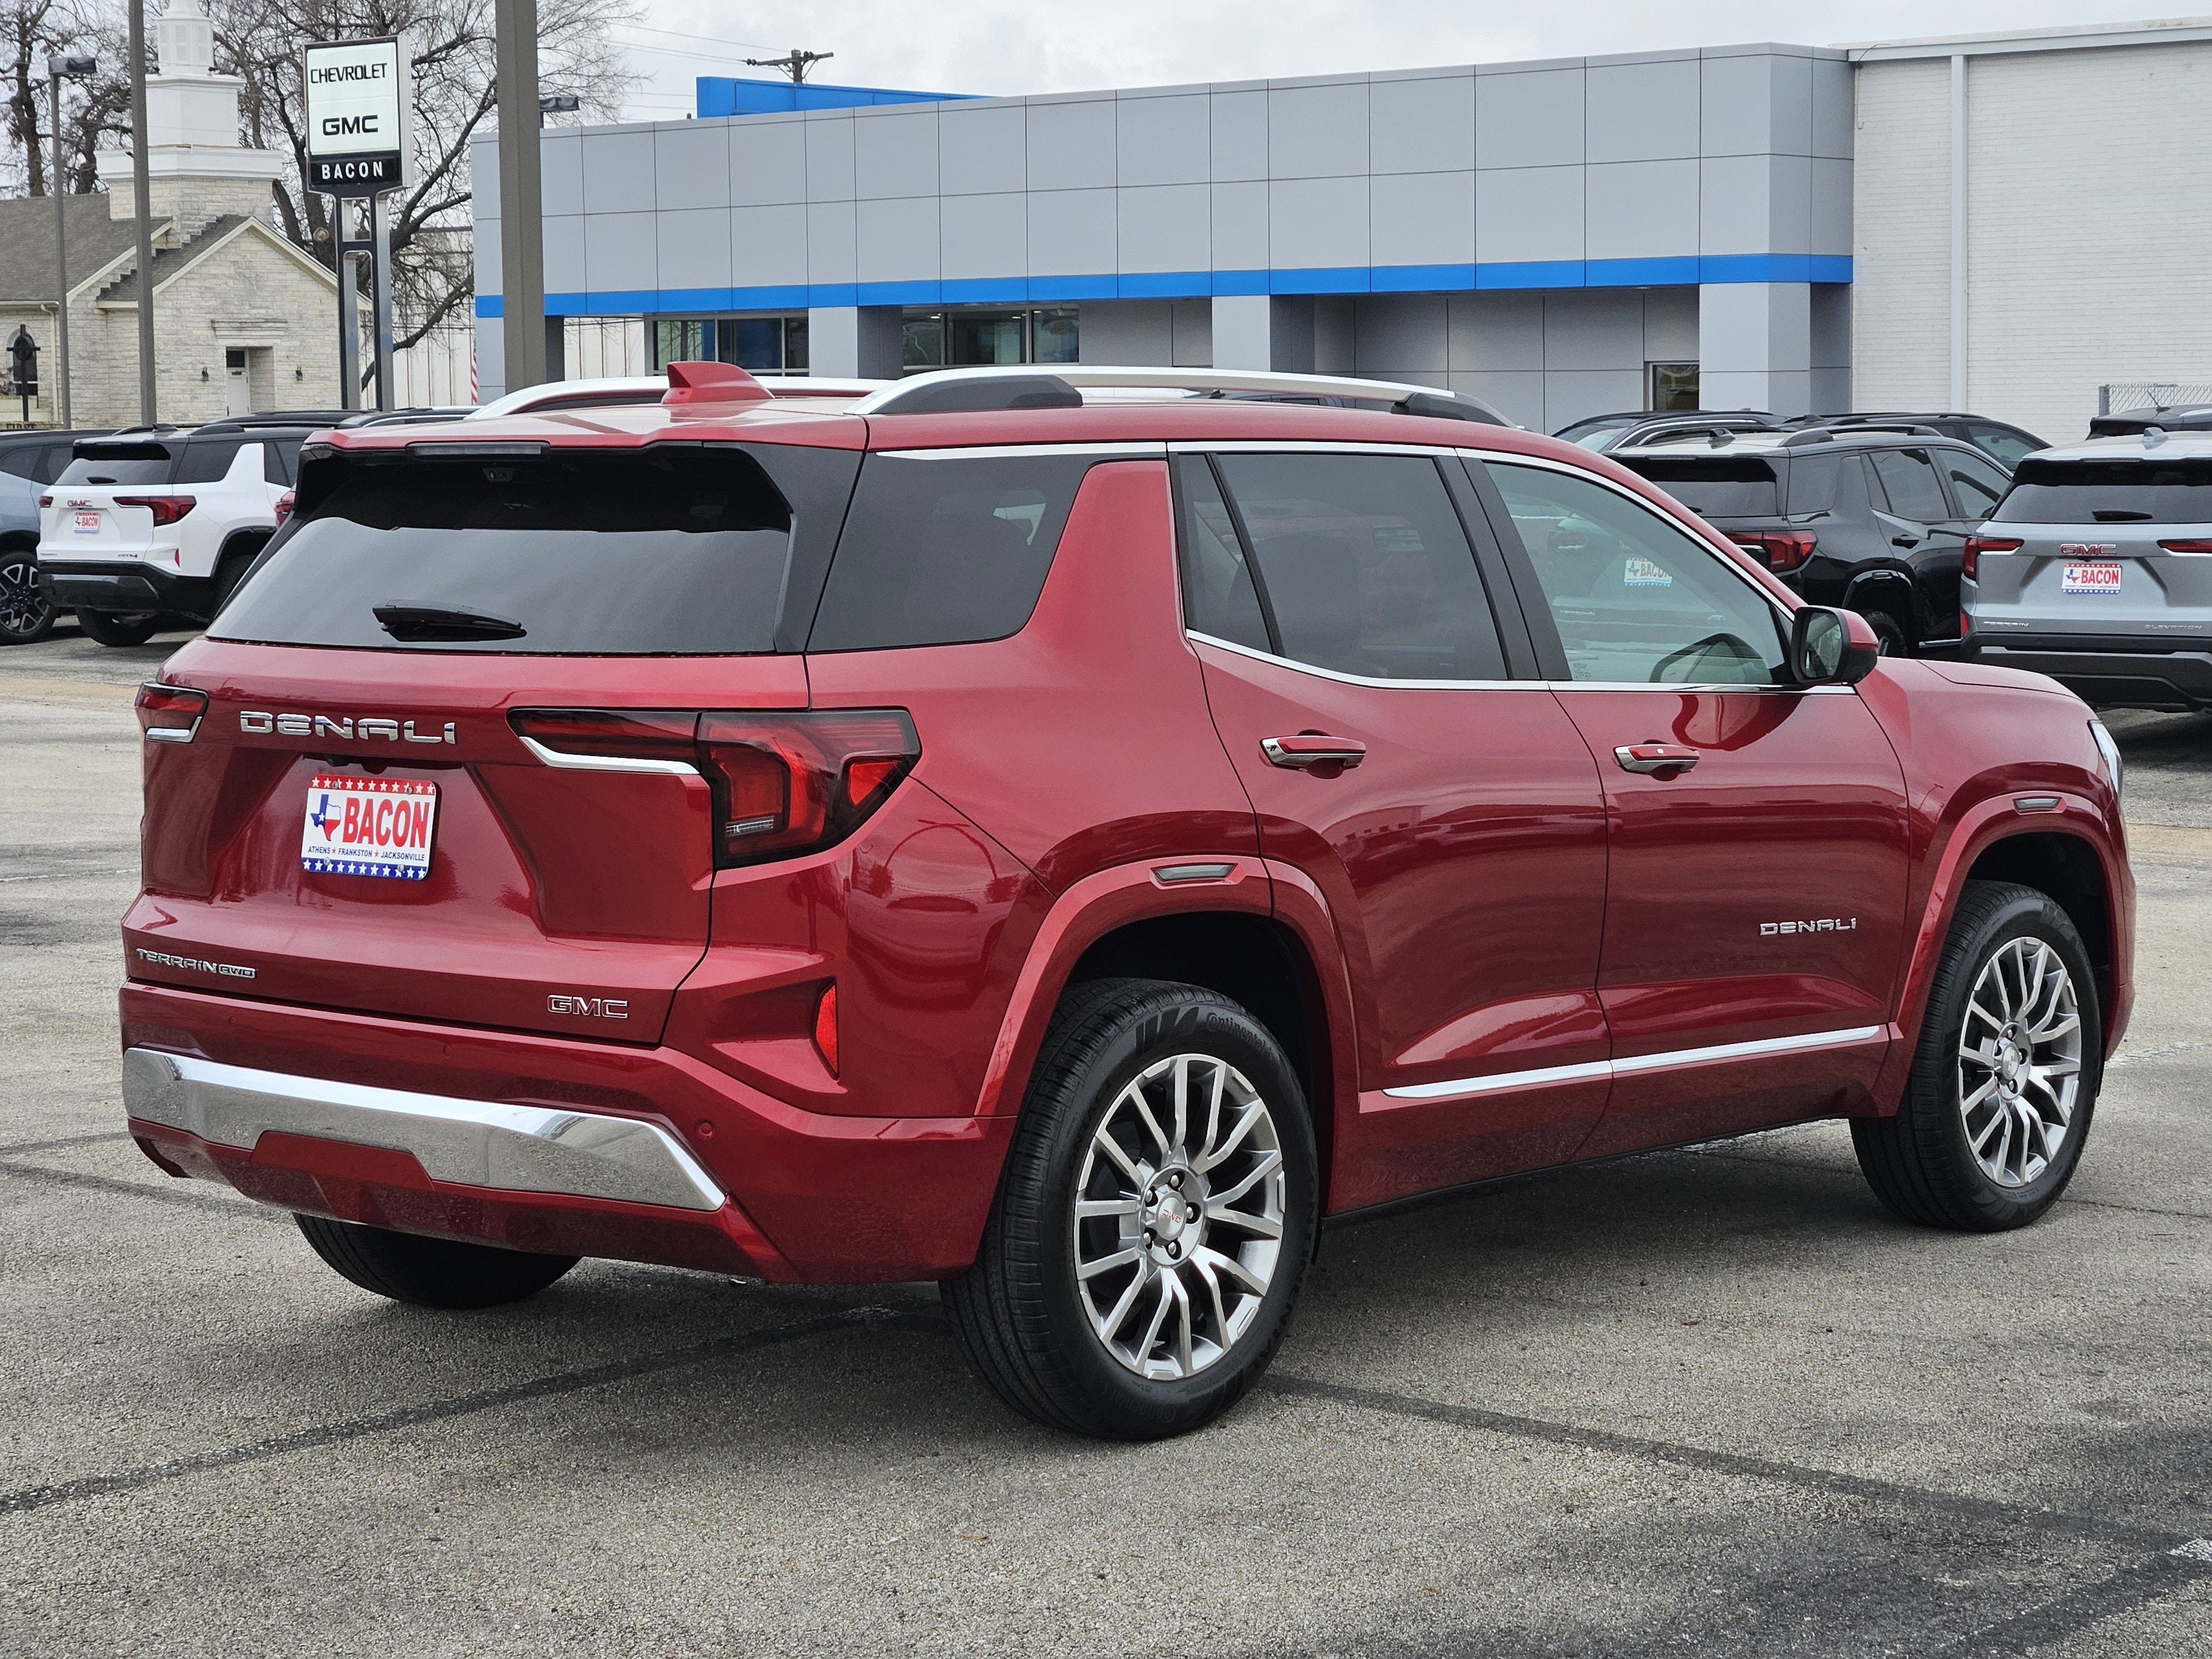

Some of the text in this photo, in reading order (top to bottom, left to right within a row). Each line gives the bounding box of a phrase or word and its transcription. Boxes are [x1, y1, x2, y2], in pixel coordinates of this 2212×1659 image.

[310, 62, 387, 84] CHEVROLET
[322, 114, 378, 135] GMC
[321, 161, 383, 179] BACON
[2060, 544, 2116, 556] GMC
[2081, 570, 2119, 584] BACON
[239, 711, 456, 744] DENALI
[342, 797, 430, 848] BACON
[307, 846, 425, 862] ATHENS FRANKSTON JACKSONVILLE
[1760, 917, 1856, 936] DENALI
[136, 948, 255, 979] TERRAIN AWD
[547, 995, 628, 1019] GMC
[1162, 1209, 1181, 1223] GMC
